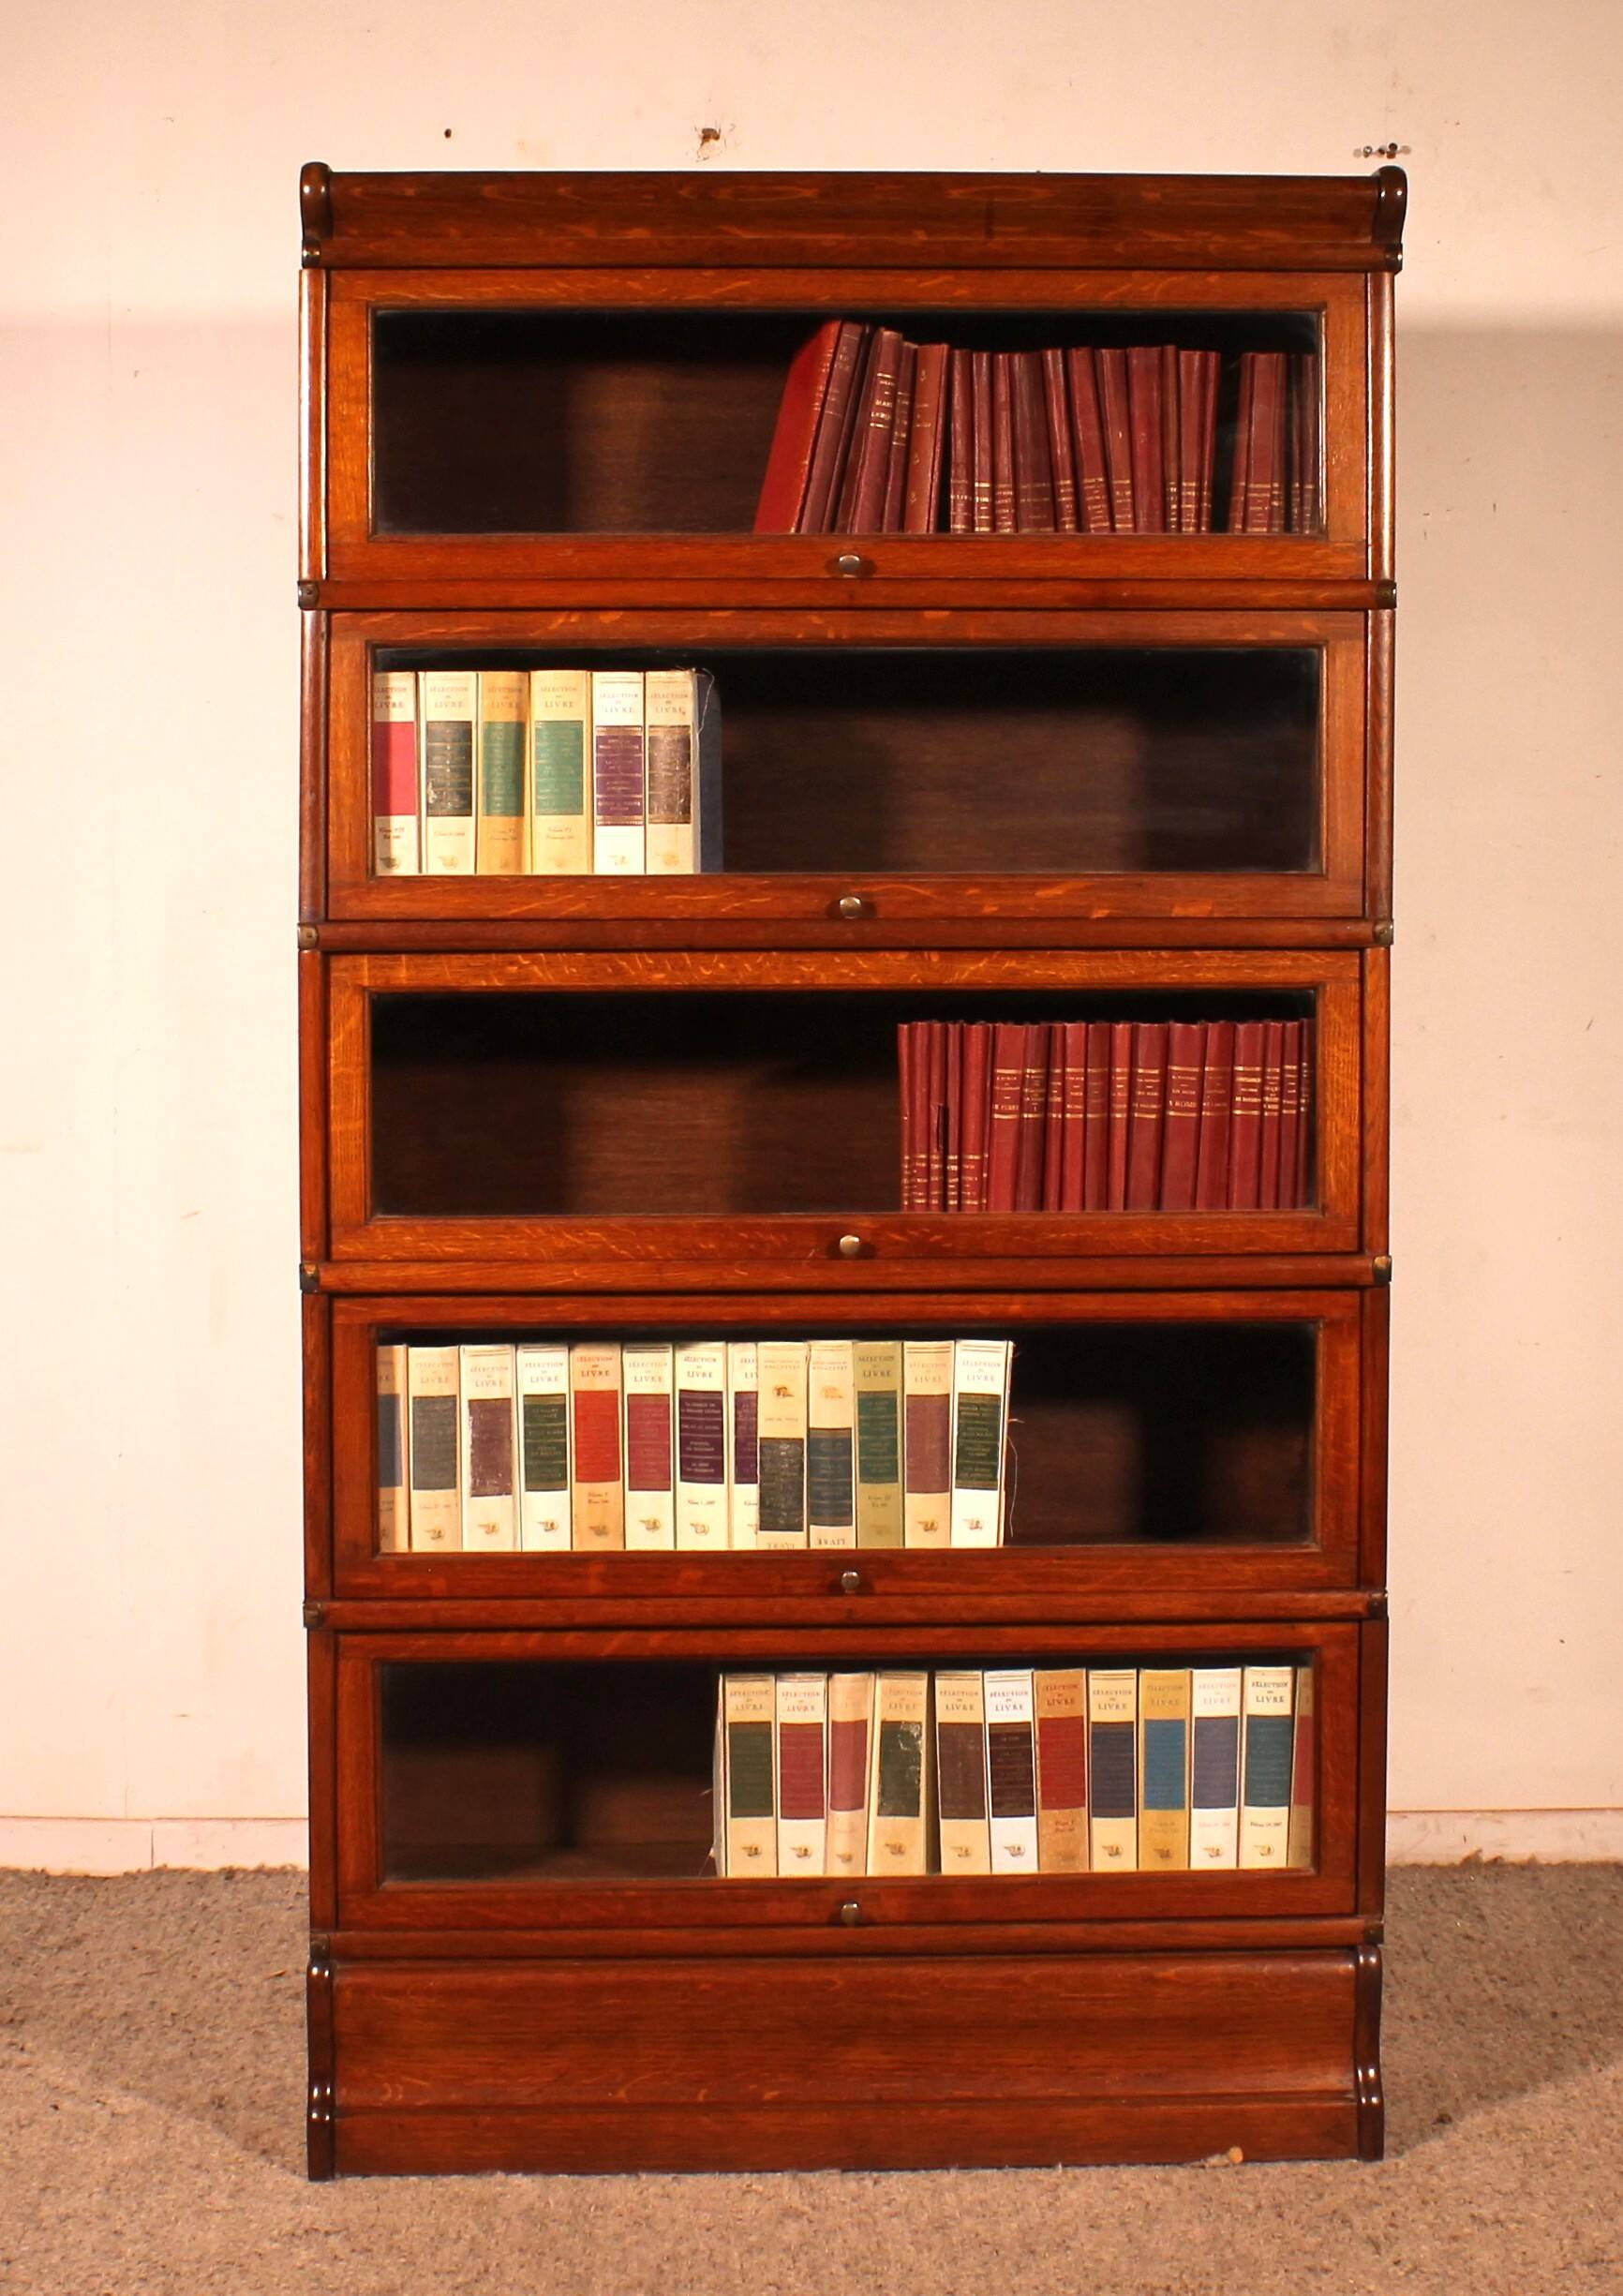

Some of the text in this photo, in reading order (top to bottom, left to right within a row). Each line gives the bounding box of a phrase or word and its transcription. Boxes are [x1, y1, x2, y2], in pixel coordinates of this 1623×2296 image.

[580, 1369, 610, 1378] LIVRE
[687, 1370, 713, 1379] LIVRE
[862, 1369, 891, 1379] LIVRE
[1046, 1697, 1074, 1707] LIVRE
[1256, 1694, 1285, 1704] LIVRE
[945, 1703, 975, 1711] LIVRE
[994, 1703, 1024, 1712] LIVRE
[1097, 1702, 1128, 1711] LIVRE
